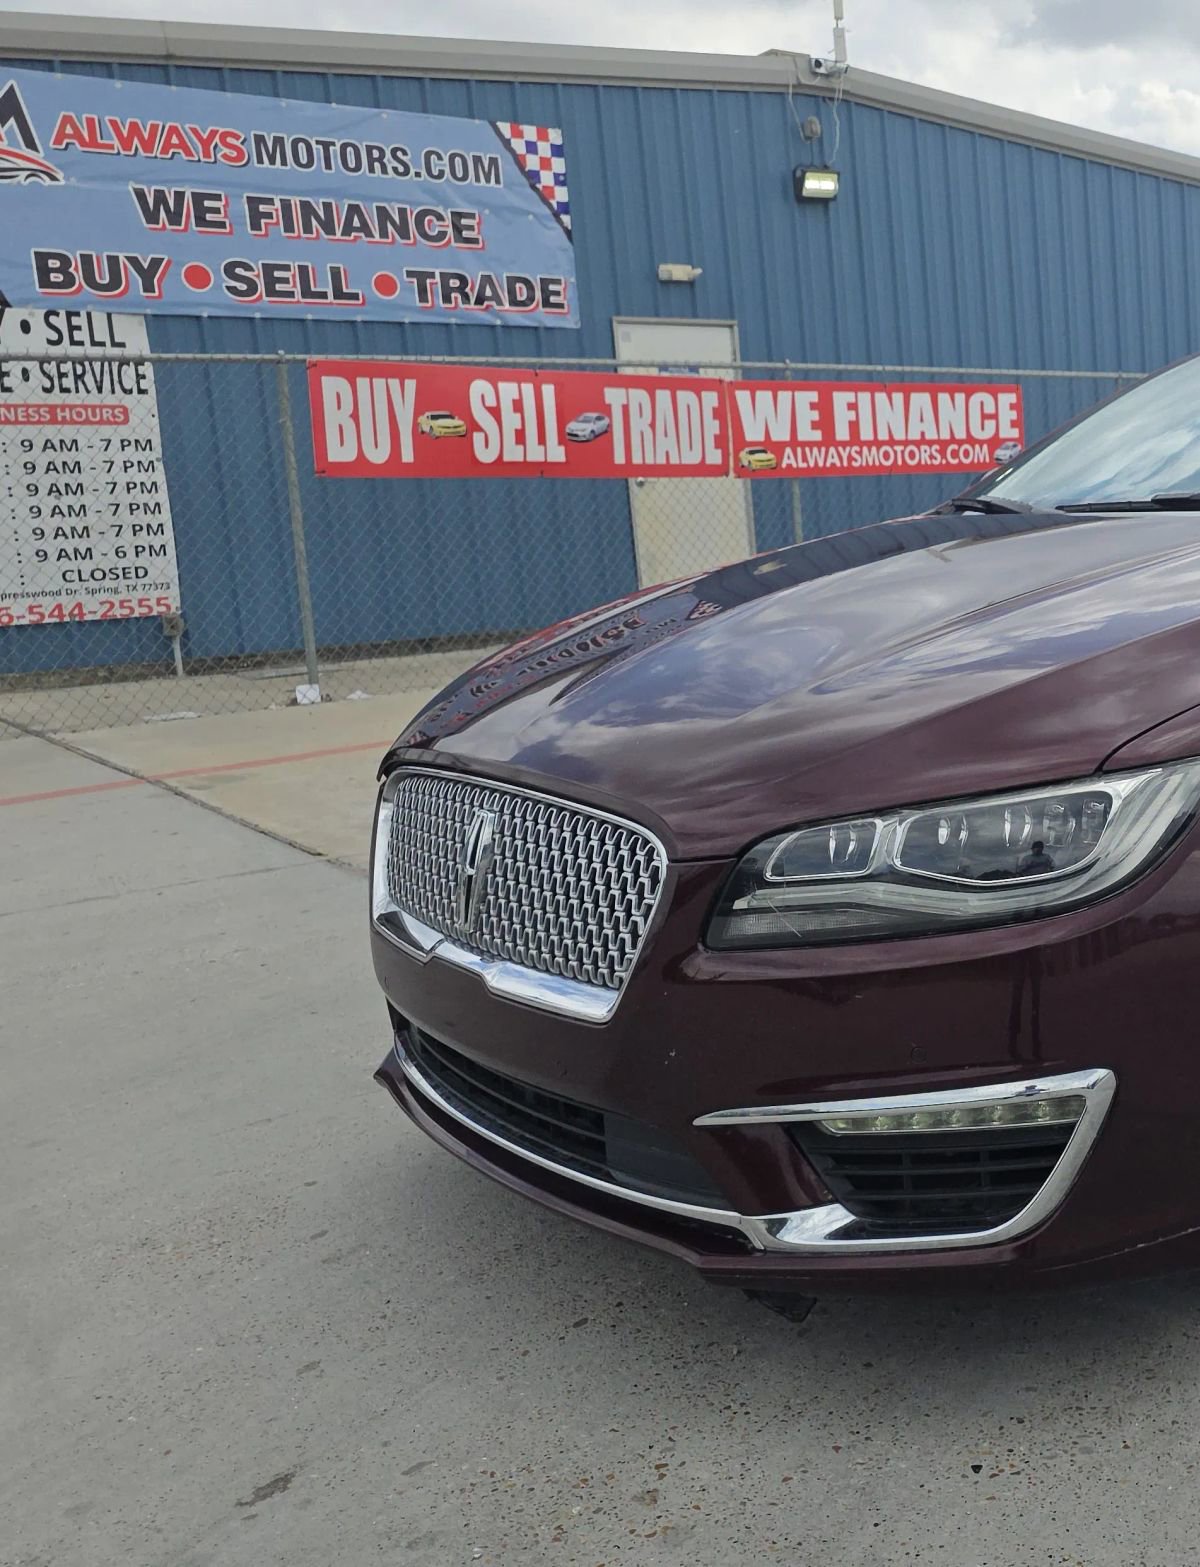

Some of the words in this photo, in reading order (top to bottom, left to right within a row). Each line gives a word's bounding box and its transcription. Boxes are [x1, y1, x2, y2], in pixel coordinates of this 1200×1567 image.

[131, 185, 231, 233] WE
[244, 194, 484, 249] FINANCE
[32, 249, 170, 298] BUY
[221, 260, 364, 305] SELL
[405, 269, 569, 313] TRADE
[43, 310, 126, 348] SELL
[39, 361, 148, 395] SERVICE
[57, 408, 125, 422] HOURS
[321, 376, 416, 463] BUY
[469, 379, 566, 463] SELL
[604, 387, 722, 465] TRADE
[735, 390, 822, 441] WE
[832, 391, 1020, 442] FINANCE
[20, 439, 33, 452] 9
[42, 439, 79, 452] AM
[100, 439, 112, 451] 7
[120, 439, 153, 451] PM
[781, 444, 990, 469] ALWAYSMOTORS.COM
[23, 461, 36, 475] 9
[44, 461, 82, 474] AM
[102, 460, 115, 473] 7
[123, 460, 155, 473] PM
[26, 483, 39, 497] 9
[47, 483, 84, 496] AM
[105, 482, 117, 495] 7
[126, 481, 159, 494] PM
[29, 505, 42, 519] 9
[50, 504, 87, 518] AM
[108, 503, 120, 516] 7
[129, 502, 162, 515] PM
[32, 527, 45, 541] 9
[53, 525, 90, 540] AM
[110, 524, 123, 538] 7
[132, 523, 165, 537] PM
[35, 549, 48, 563] 9
[56, 547, 94, 561] AM
[115, 545, 127, 559] 6
[134, 544, 167, 558] PM
[62, 566, 148, 583] CLOSED
[126, 584, 138, 594] TX
[141, 583, 171, 592] 77373
